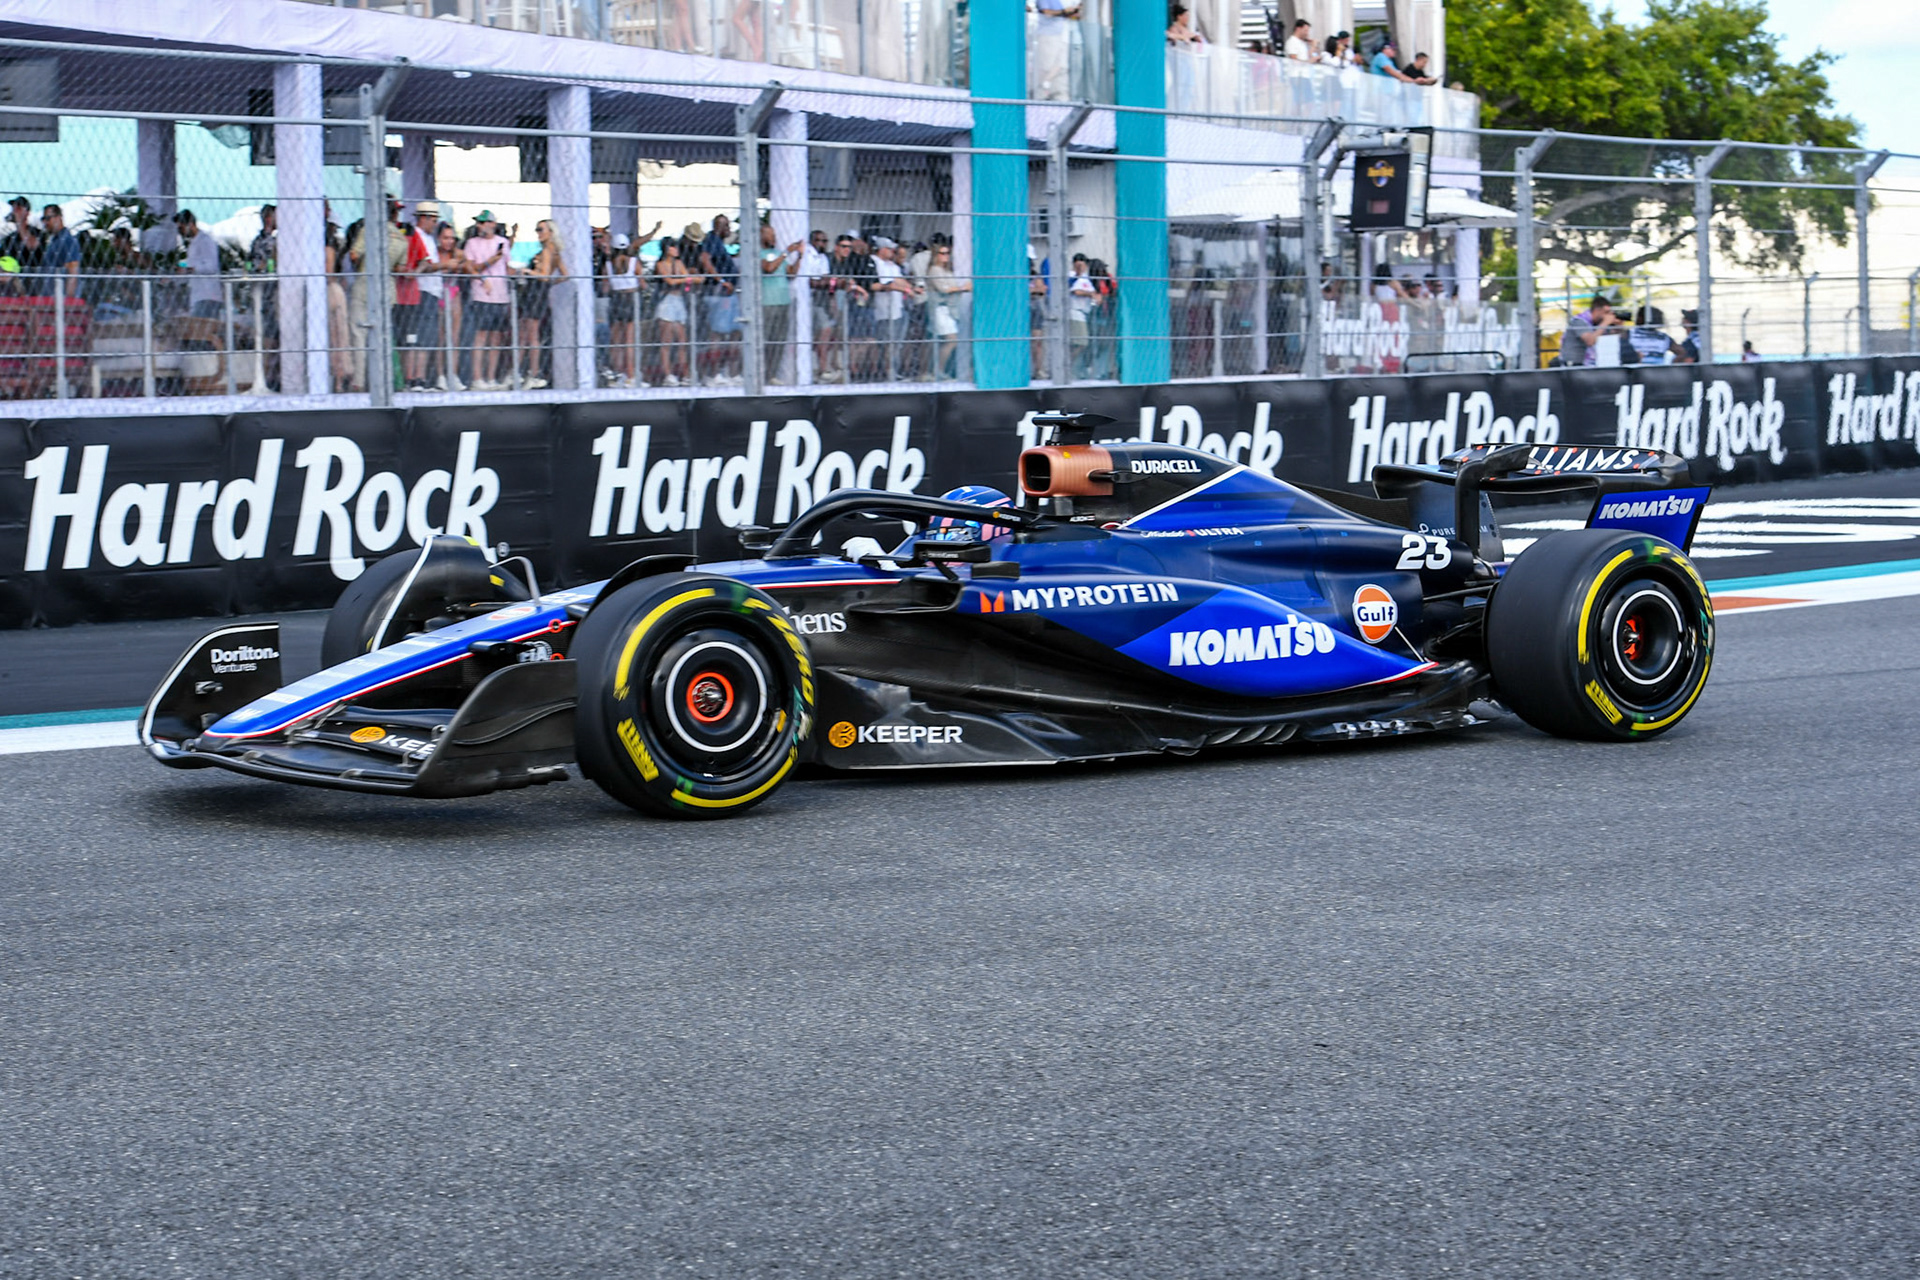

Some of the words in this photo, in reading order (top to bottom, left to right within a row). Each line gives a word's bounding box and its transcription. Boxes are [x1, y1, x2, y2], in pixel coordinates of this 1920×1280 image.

[1825, 370, 1905, 446] Hard
[1615, 380, 1703, 459] Hard
[1705, 377, 1788, 471] Rock
[590, 421, 768, 537] Hard
[1131, 460, 1202, 473] DURACELL
[24, 438, 284, 571] Hard
[292, 431, 500, 581] Rock
[1599, 494, 1695, 520] KOMATSU
[1193, 527, 1244, 536] ULTRA
[1396, 534, 1452, 570] 23
[1011, 582, 1179, 611] MYPROTEIN
[1357, 605, 1396, 624] Gulf
[1169, 614, 1336, 667] KOMATSU
[211, 663, 257, 674] Ventures
[857, 725, 963, 744] KEEPER
